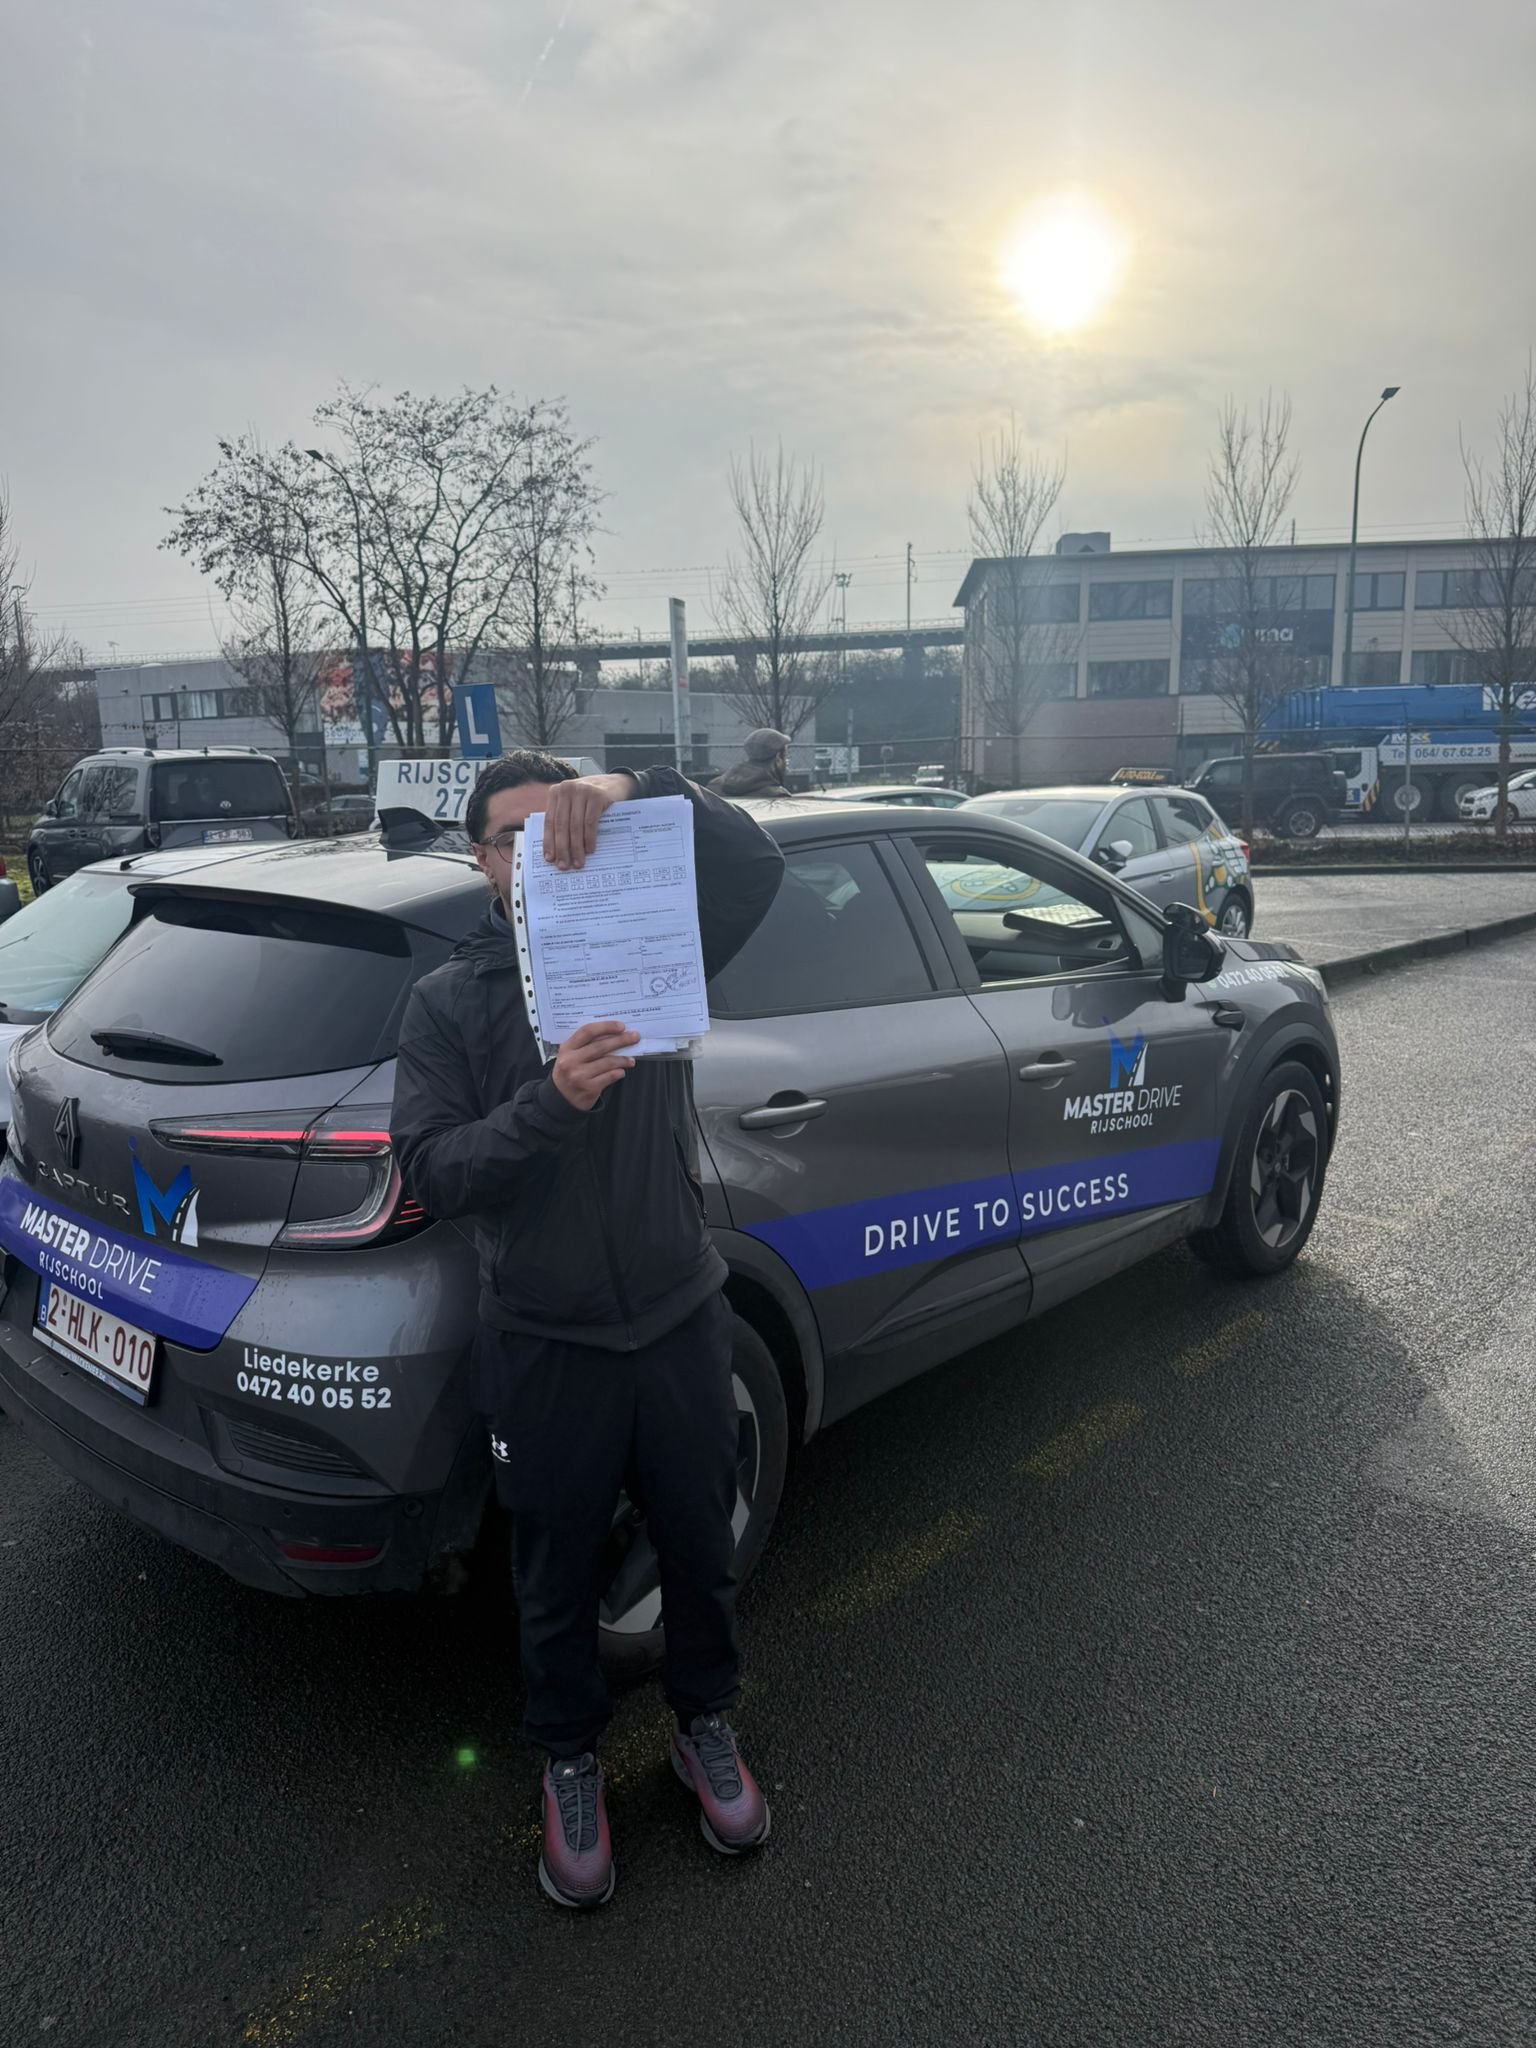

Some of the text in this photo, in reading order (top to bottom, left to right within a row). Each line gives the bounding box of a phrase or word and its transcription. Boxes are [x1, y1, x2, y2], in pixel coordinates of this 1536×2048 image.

[464, 696, 489, 744] L
[398, 761, 490, 784] RIJSCH
[434, 787, 467, 818] 27
[1217, 970, 1249, 988] 0472
[1063, 1085, 1183, 1121] MASTER DRIVE
[1090, 1112, 1154, 1134] RIJSCHOOL
[37, 1161, 131, 1217] CAPTUR
[864, 1173, 1130, 1256] DRIVE TO SUCCESS
[19, 1201, 163, 1295] MASTER DRIVE
[38, 1250, 104, 1300] RIJSCHOOL
[243, 1347, 380, 1383] Liedekerke
[236, 1372, 392, 1410] 0472 40 05 52
